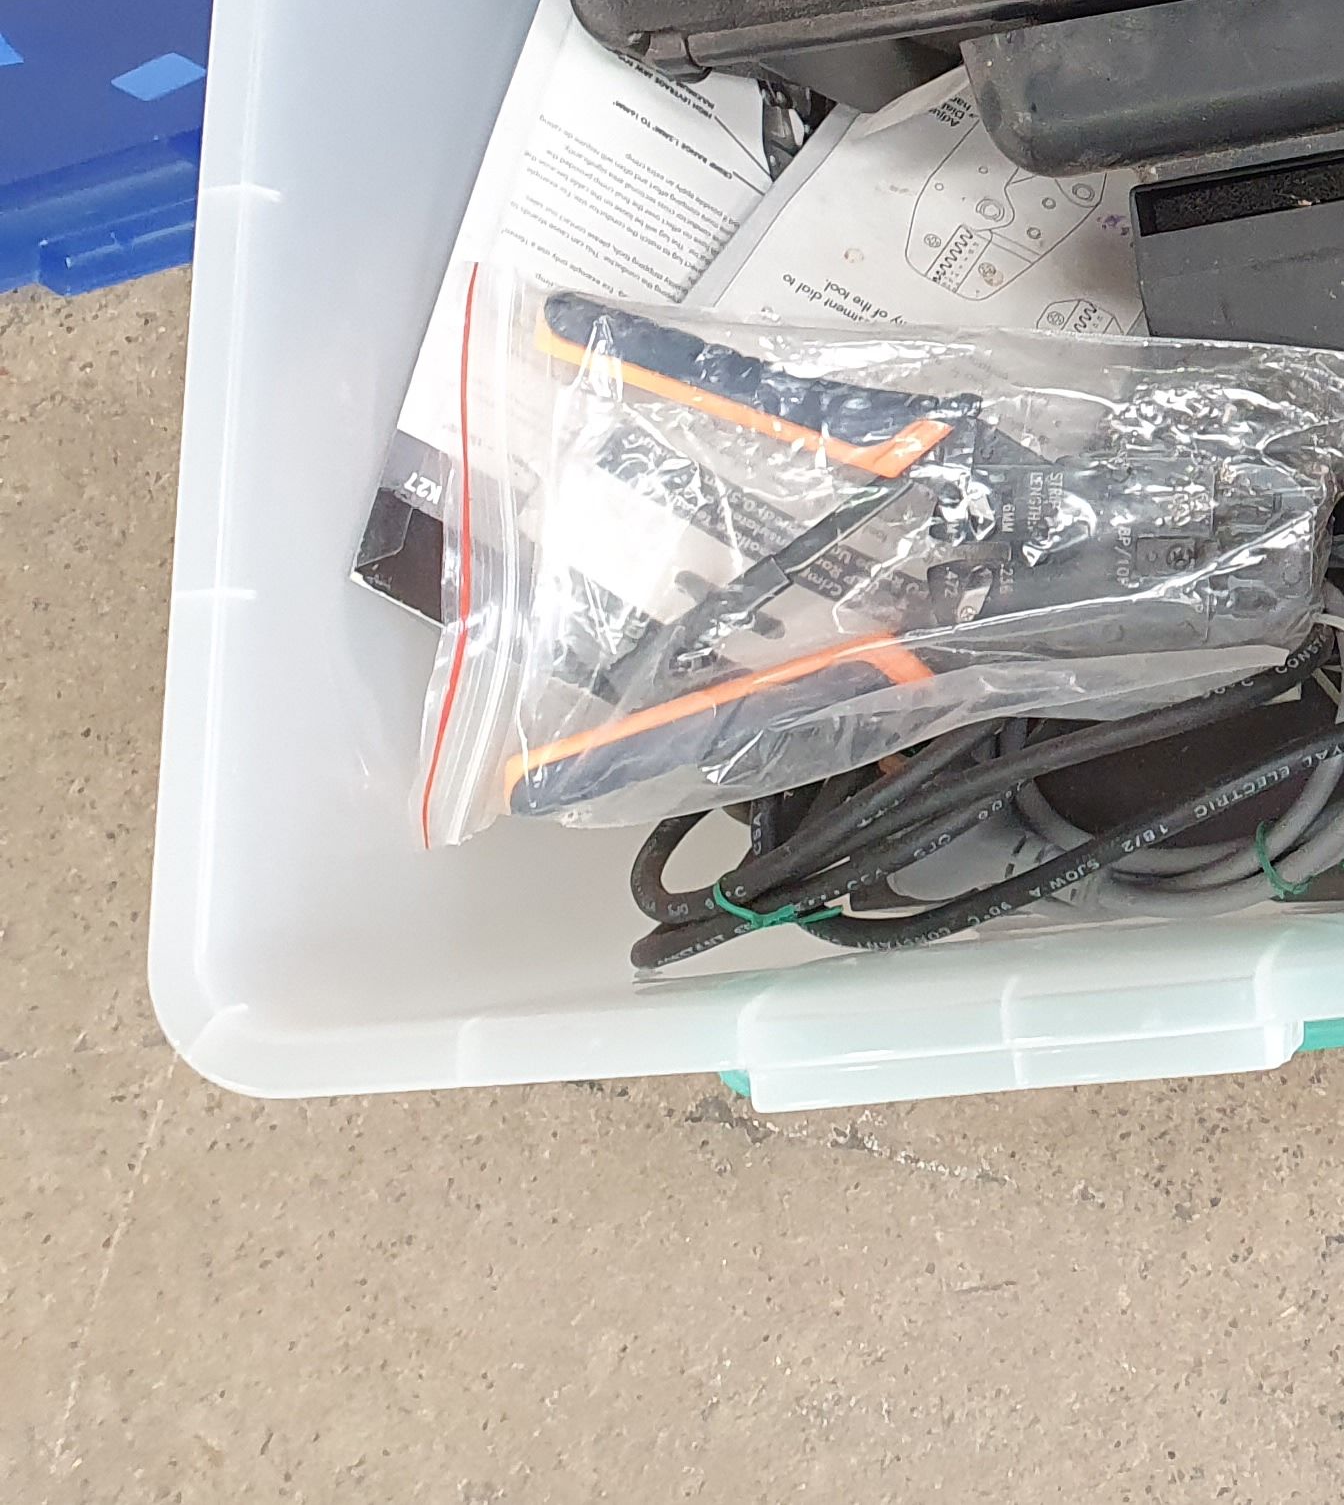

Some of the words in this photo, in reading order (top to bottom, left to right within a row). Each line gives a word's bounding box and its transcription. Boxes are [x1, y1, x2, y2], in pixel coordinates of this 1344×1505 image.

[940, 102, 964, 119] Dial
[780, 271, 796, 287] to
[819, 277, 851, 303] tool.
[794, 280, 823, 305] dial
[848, 293, 873, 315] the
[870, 304, 889, 324] of
[402, 471, 442, 504] K27
[1001, 504, 1014, 532] 6MM
[944, 566, 958, 598] .472
[1191, 763, 1291, 820] ELECTRIC
[1045, 855, 1102, 891] SJOW
